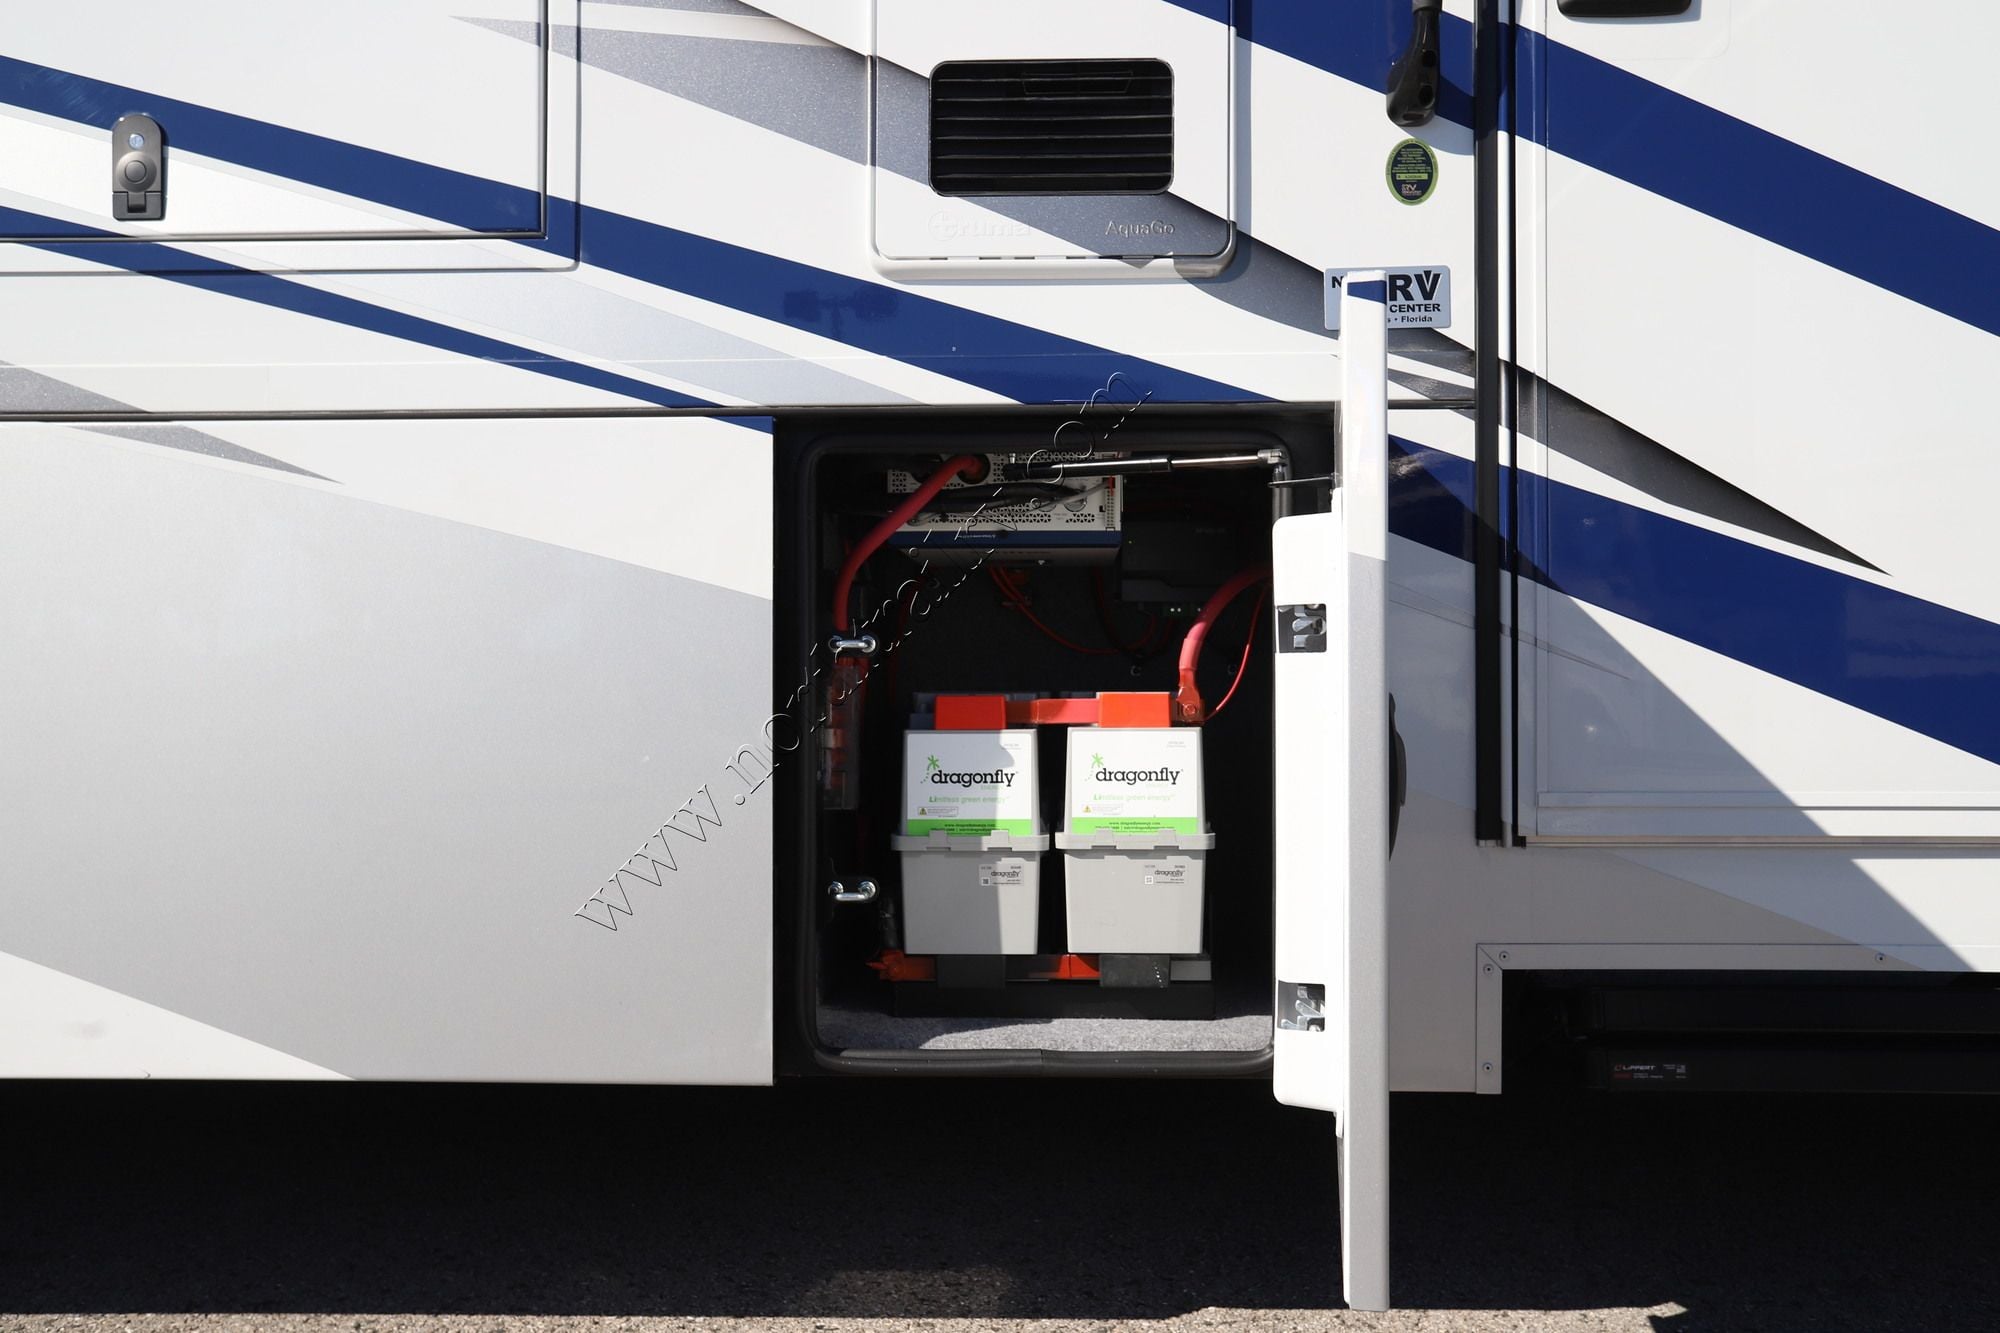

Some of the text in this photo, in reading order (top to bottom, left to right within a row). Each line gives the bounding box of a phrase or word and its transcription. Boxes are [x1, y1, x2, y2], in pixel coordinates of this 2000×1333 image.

[1105, 220, 1175, 238] AquaGo
[1389, 270, 1442, 302] RV
[1389, 303, 1441, 313] CENTER
[1401, 315, 1433, 323] Florida
[931, 769, 1015, 788] dragonfly
[1095, 767, 1180, 785] dragonfly
